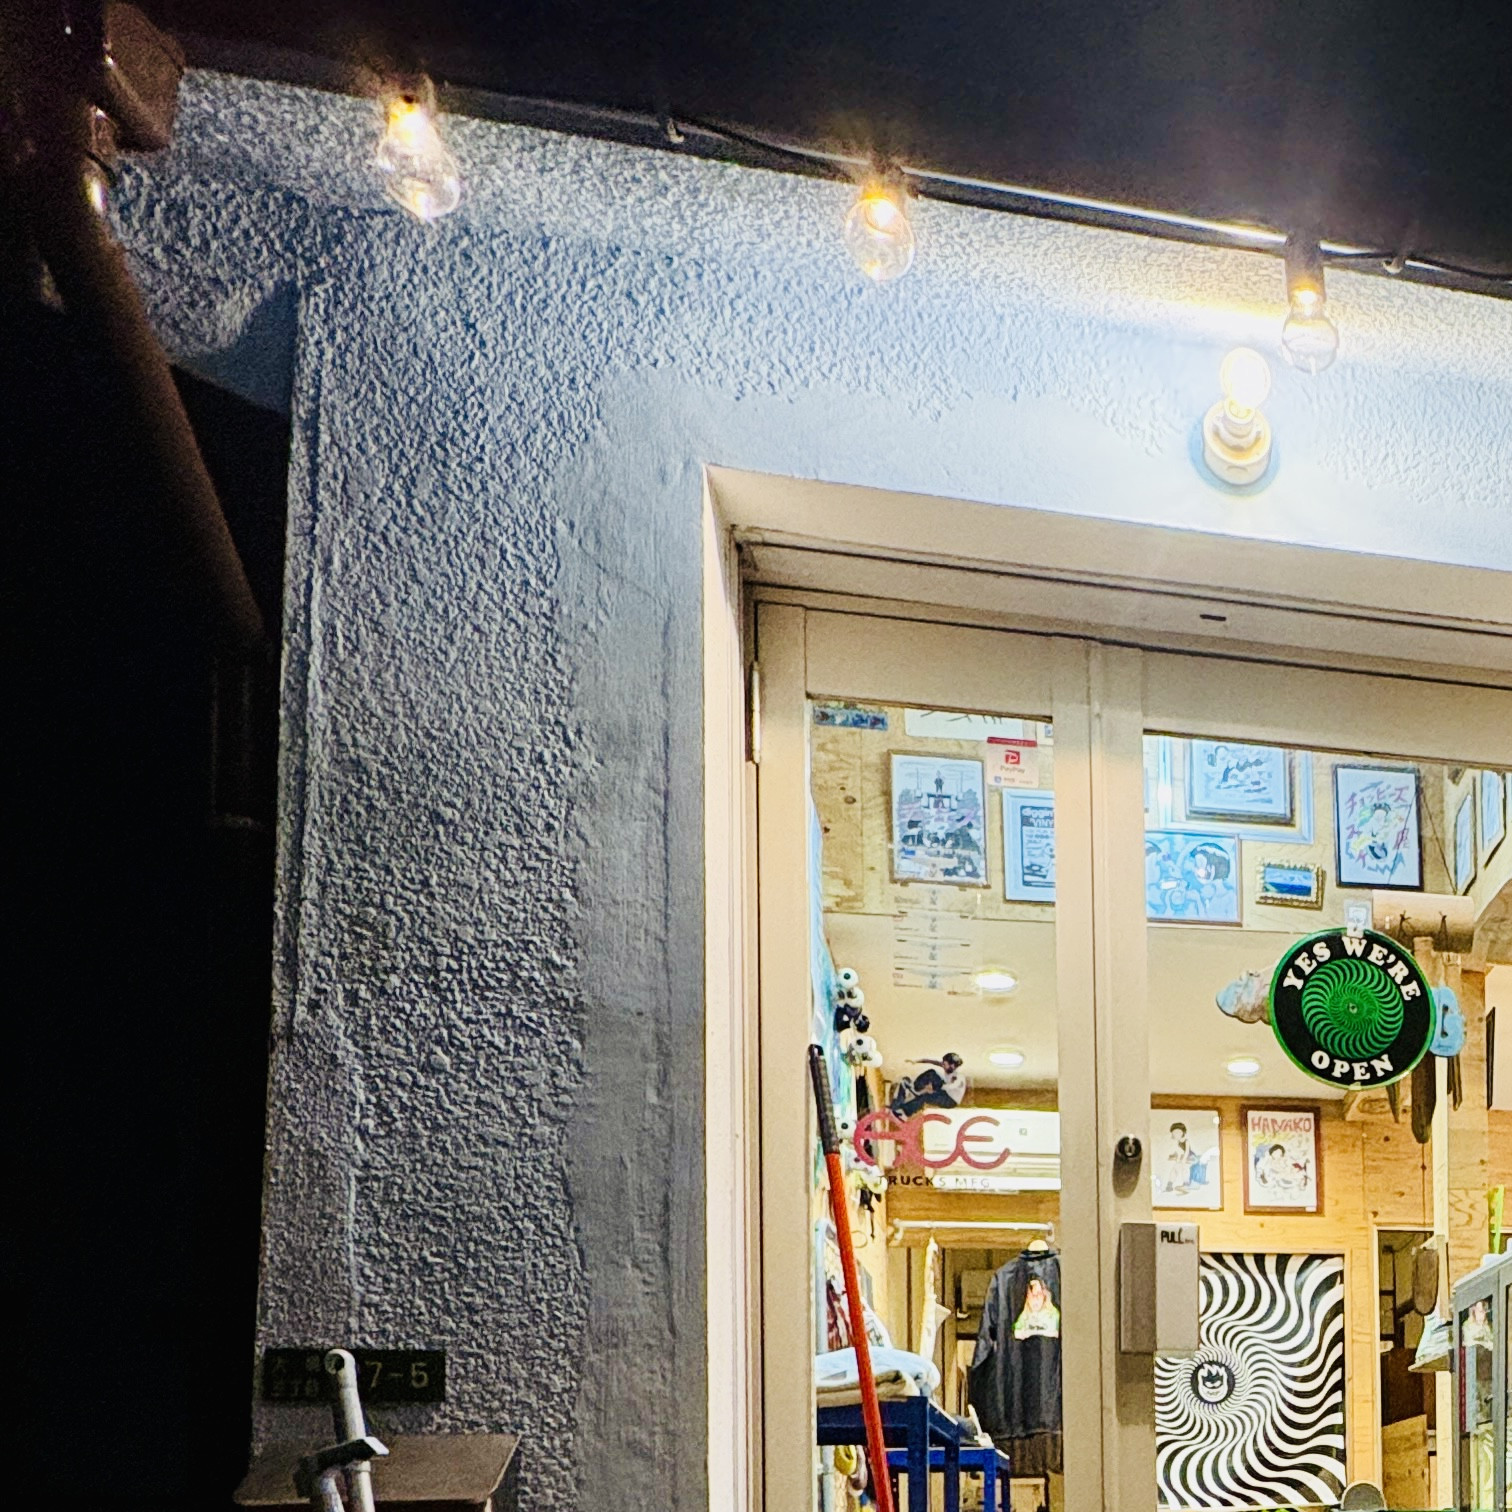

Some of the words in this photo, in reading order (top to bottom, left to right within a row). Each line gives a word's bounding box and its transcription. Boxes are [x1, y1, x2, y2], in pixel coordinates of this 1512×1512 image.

[1283, 942, 1331, 990] YES
[1341, 936, 1421, 1000] WE'RE
[1311, 1050, 1394, 1081] OPEN
